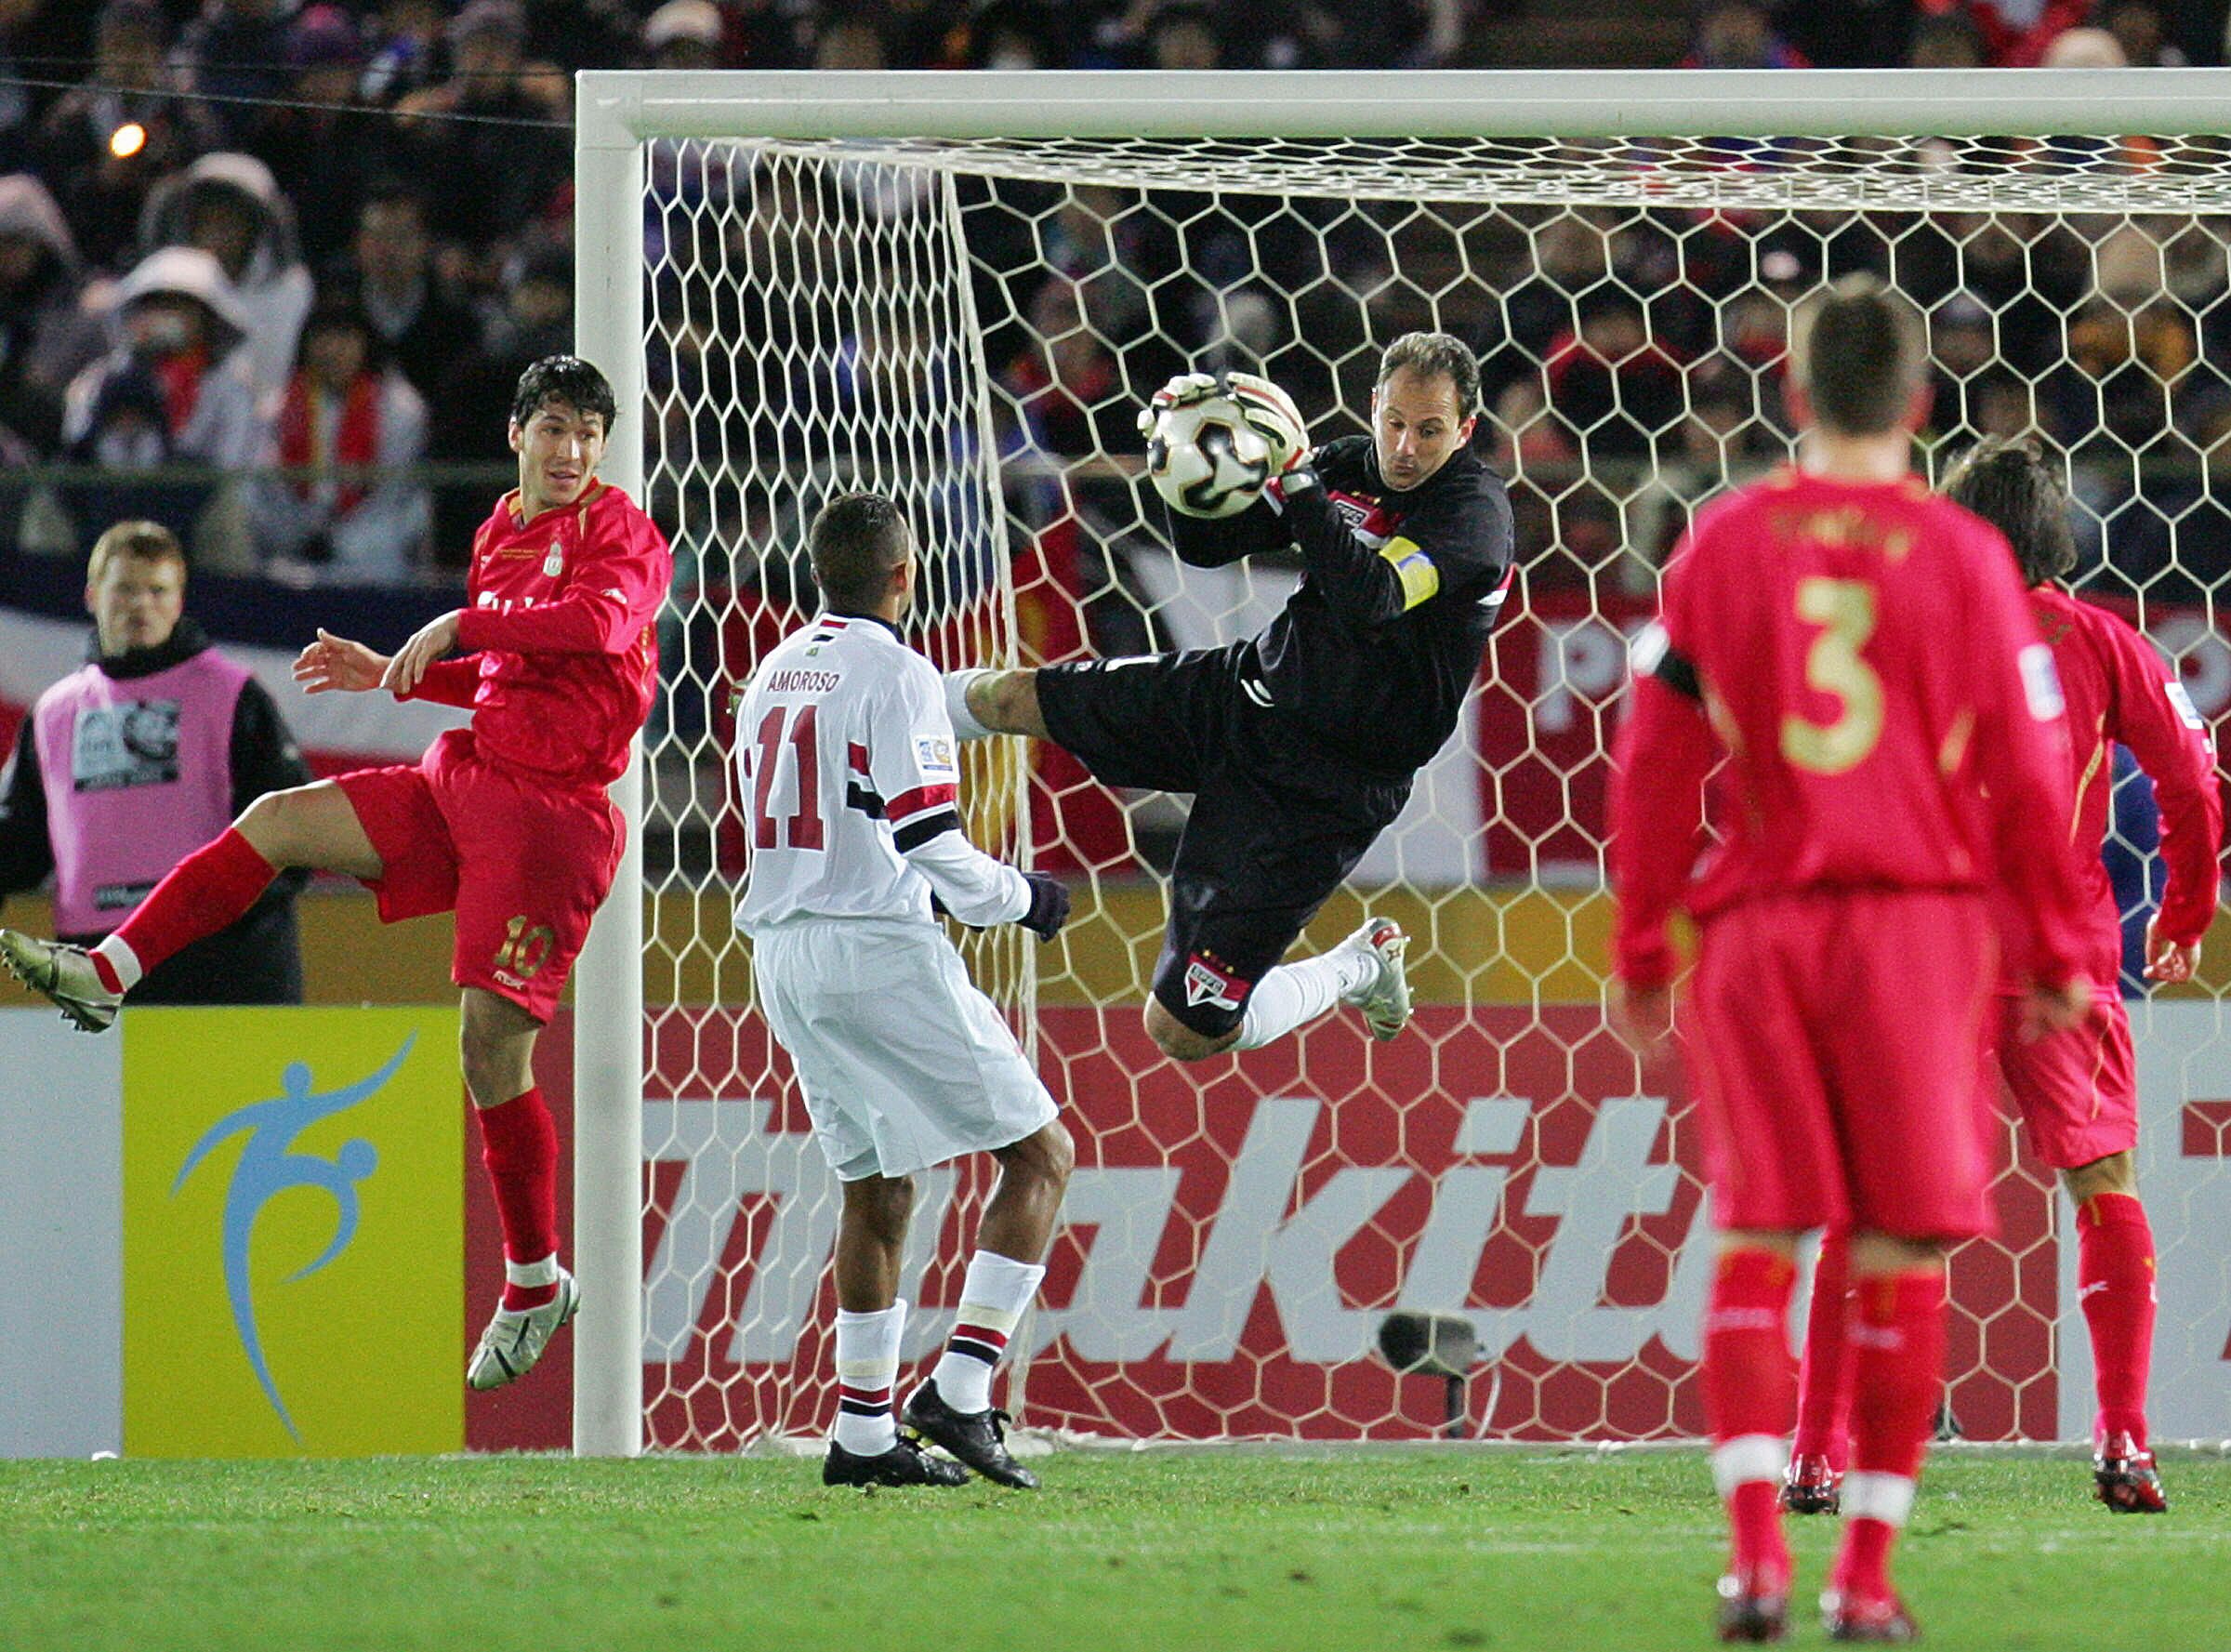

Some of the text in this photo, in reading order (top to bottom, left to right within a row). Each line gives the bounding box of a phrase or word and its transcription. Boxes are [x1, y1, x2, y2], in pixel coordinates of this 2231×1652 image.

[766, 670, 839, 693] AMOROSO
[1780, 576, 1885, 774] 3
[755, 705, 824, 851] 11
[494, 915, 555, 979] 10
